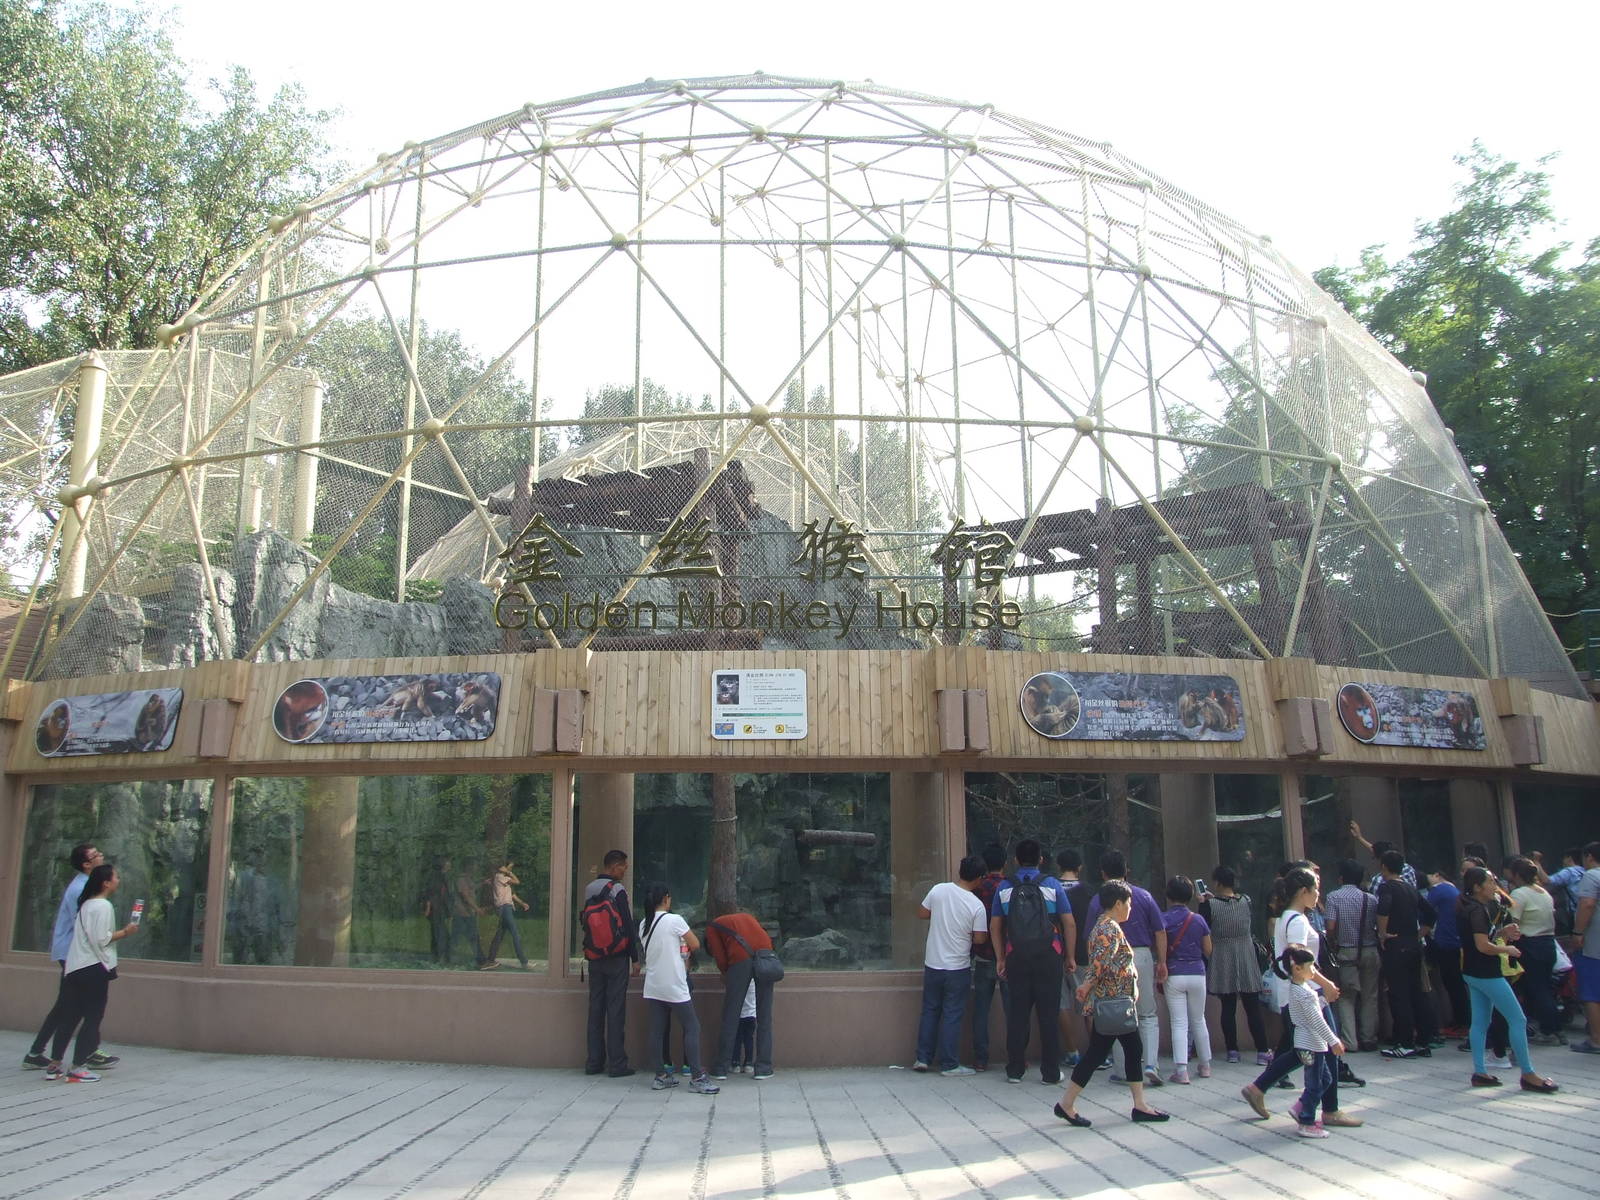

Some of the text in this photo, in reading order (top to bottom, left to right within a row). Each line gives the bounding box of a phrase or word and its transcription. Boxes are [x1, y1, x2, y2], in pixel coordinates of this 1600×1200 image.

[498, 513, 1015, 588] 金丝猴馆
[494, 591, 1022, 640] Golden Monkey House
